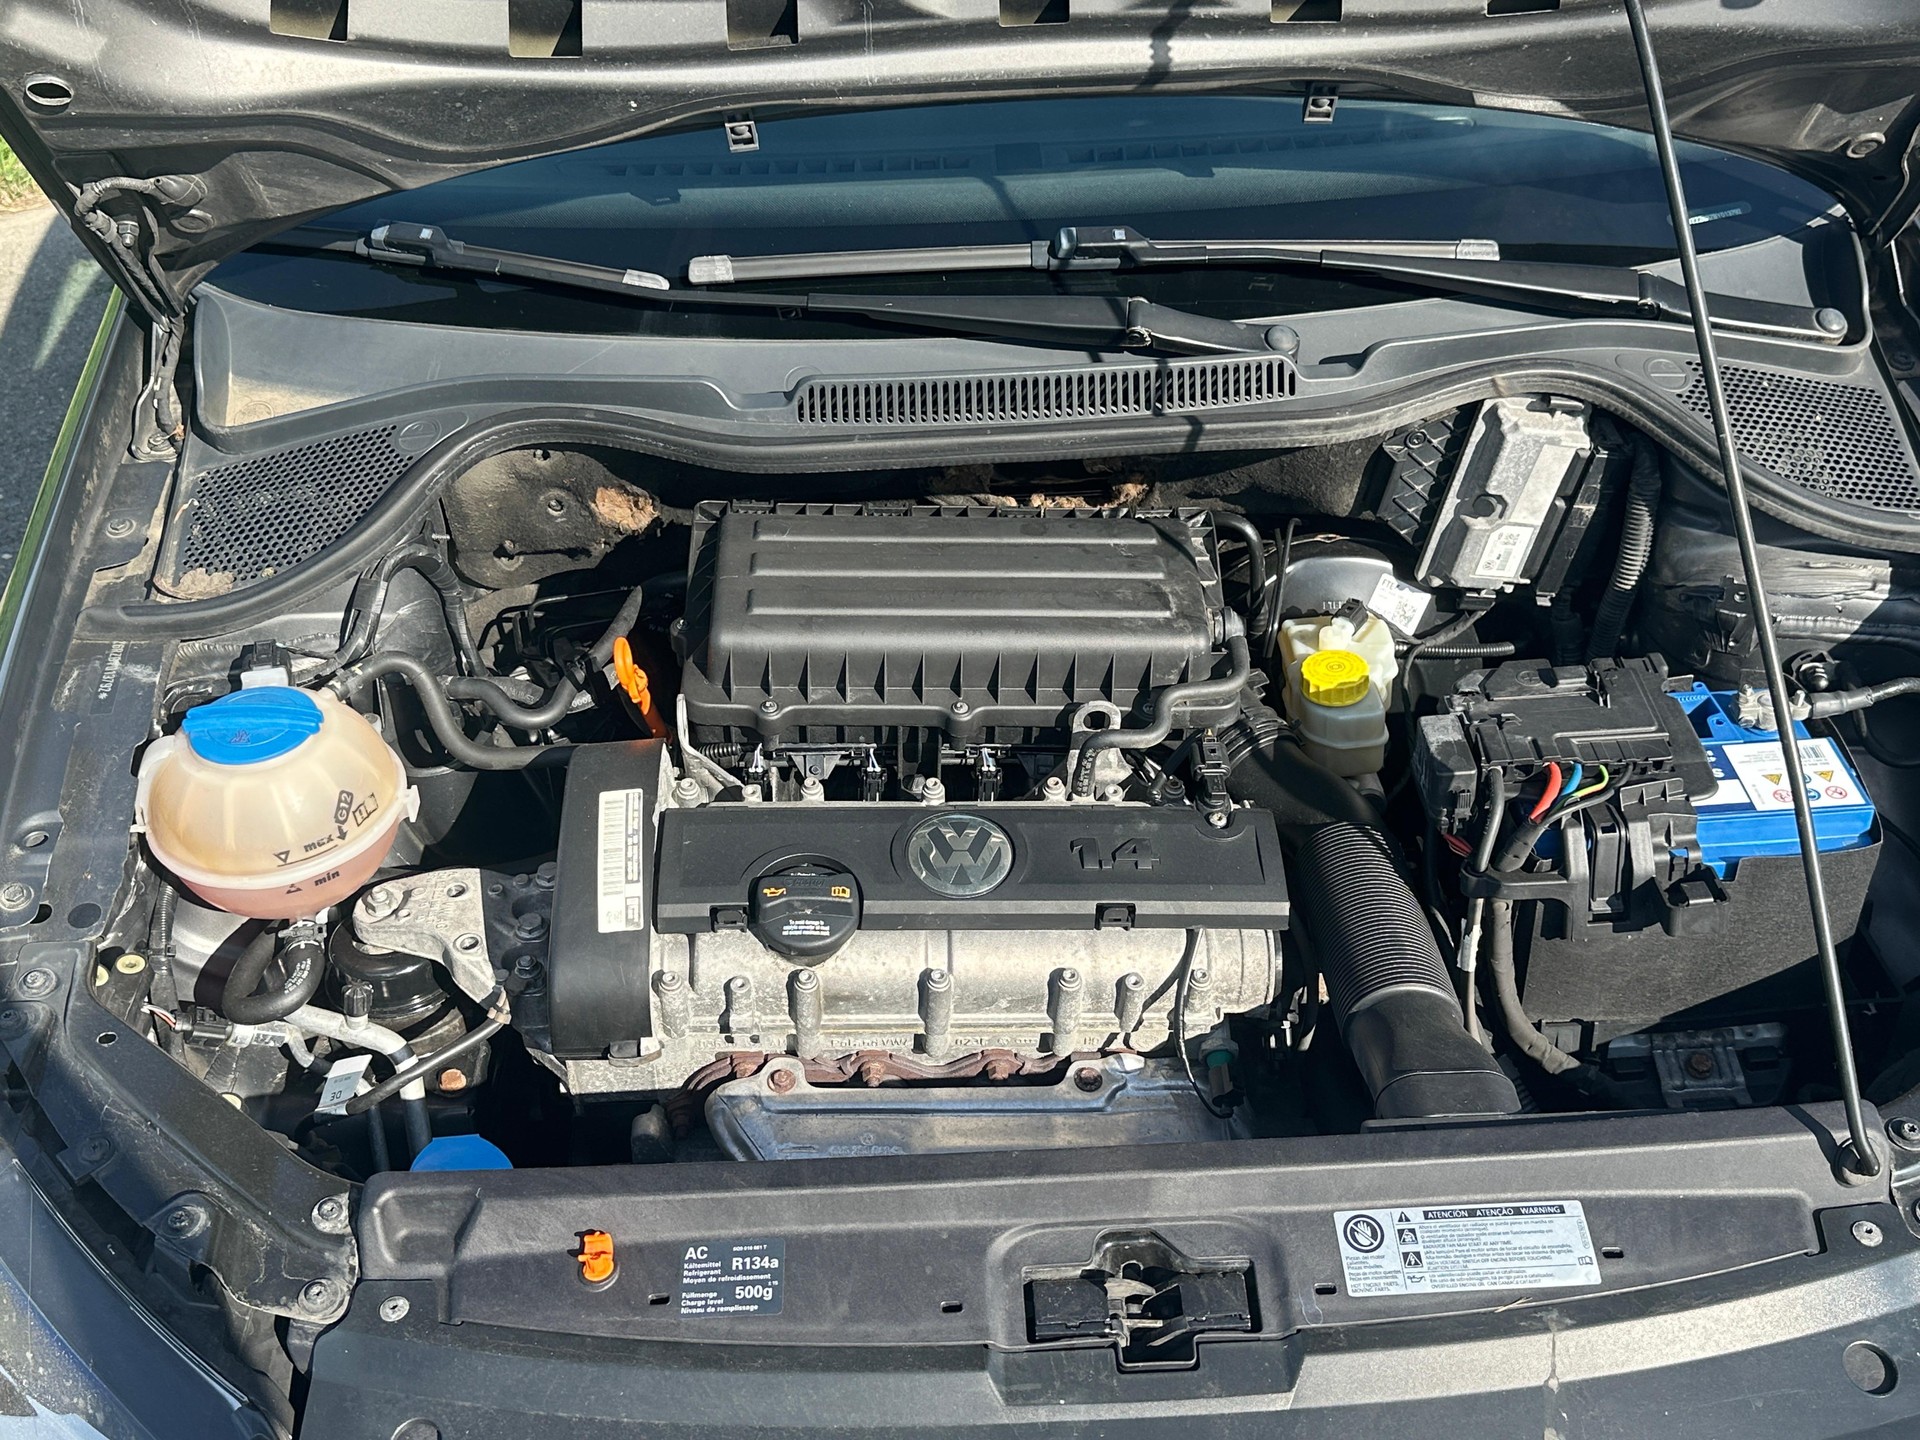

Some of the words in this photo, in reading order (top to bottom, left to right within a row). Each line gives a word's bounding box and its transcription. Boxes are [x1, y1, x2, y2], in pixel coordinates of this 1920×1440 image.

[337, 792, 352, 821] G12
[1070, 837, 1160, 869] 1.4
[314, 870, 340, 887] min
[1427, 1209, 1468, 1219] ATENCIÓN
[1476, 1206, 1514, 1217] ATENÇÃO
[1520, 1205, 1560, 1215] WARNING
[684, 1246, 708, 1260] AC
[684, 1262, 722, 1270] Kältemittel
[732, 1256, 780, 1270] R134a
[718, 1274, 772, 1282] refroidissement
[735, 1285, 773, 1300] 500g
[717, 1304, 758, 1312] remplissage
